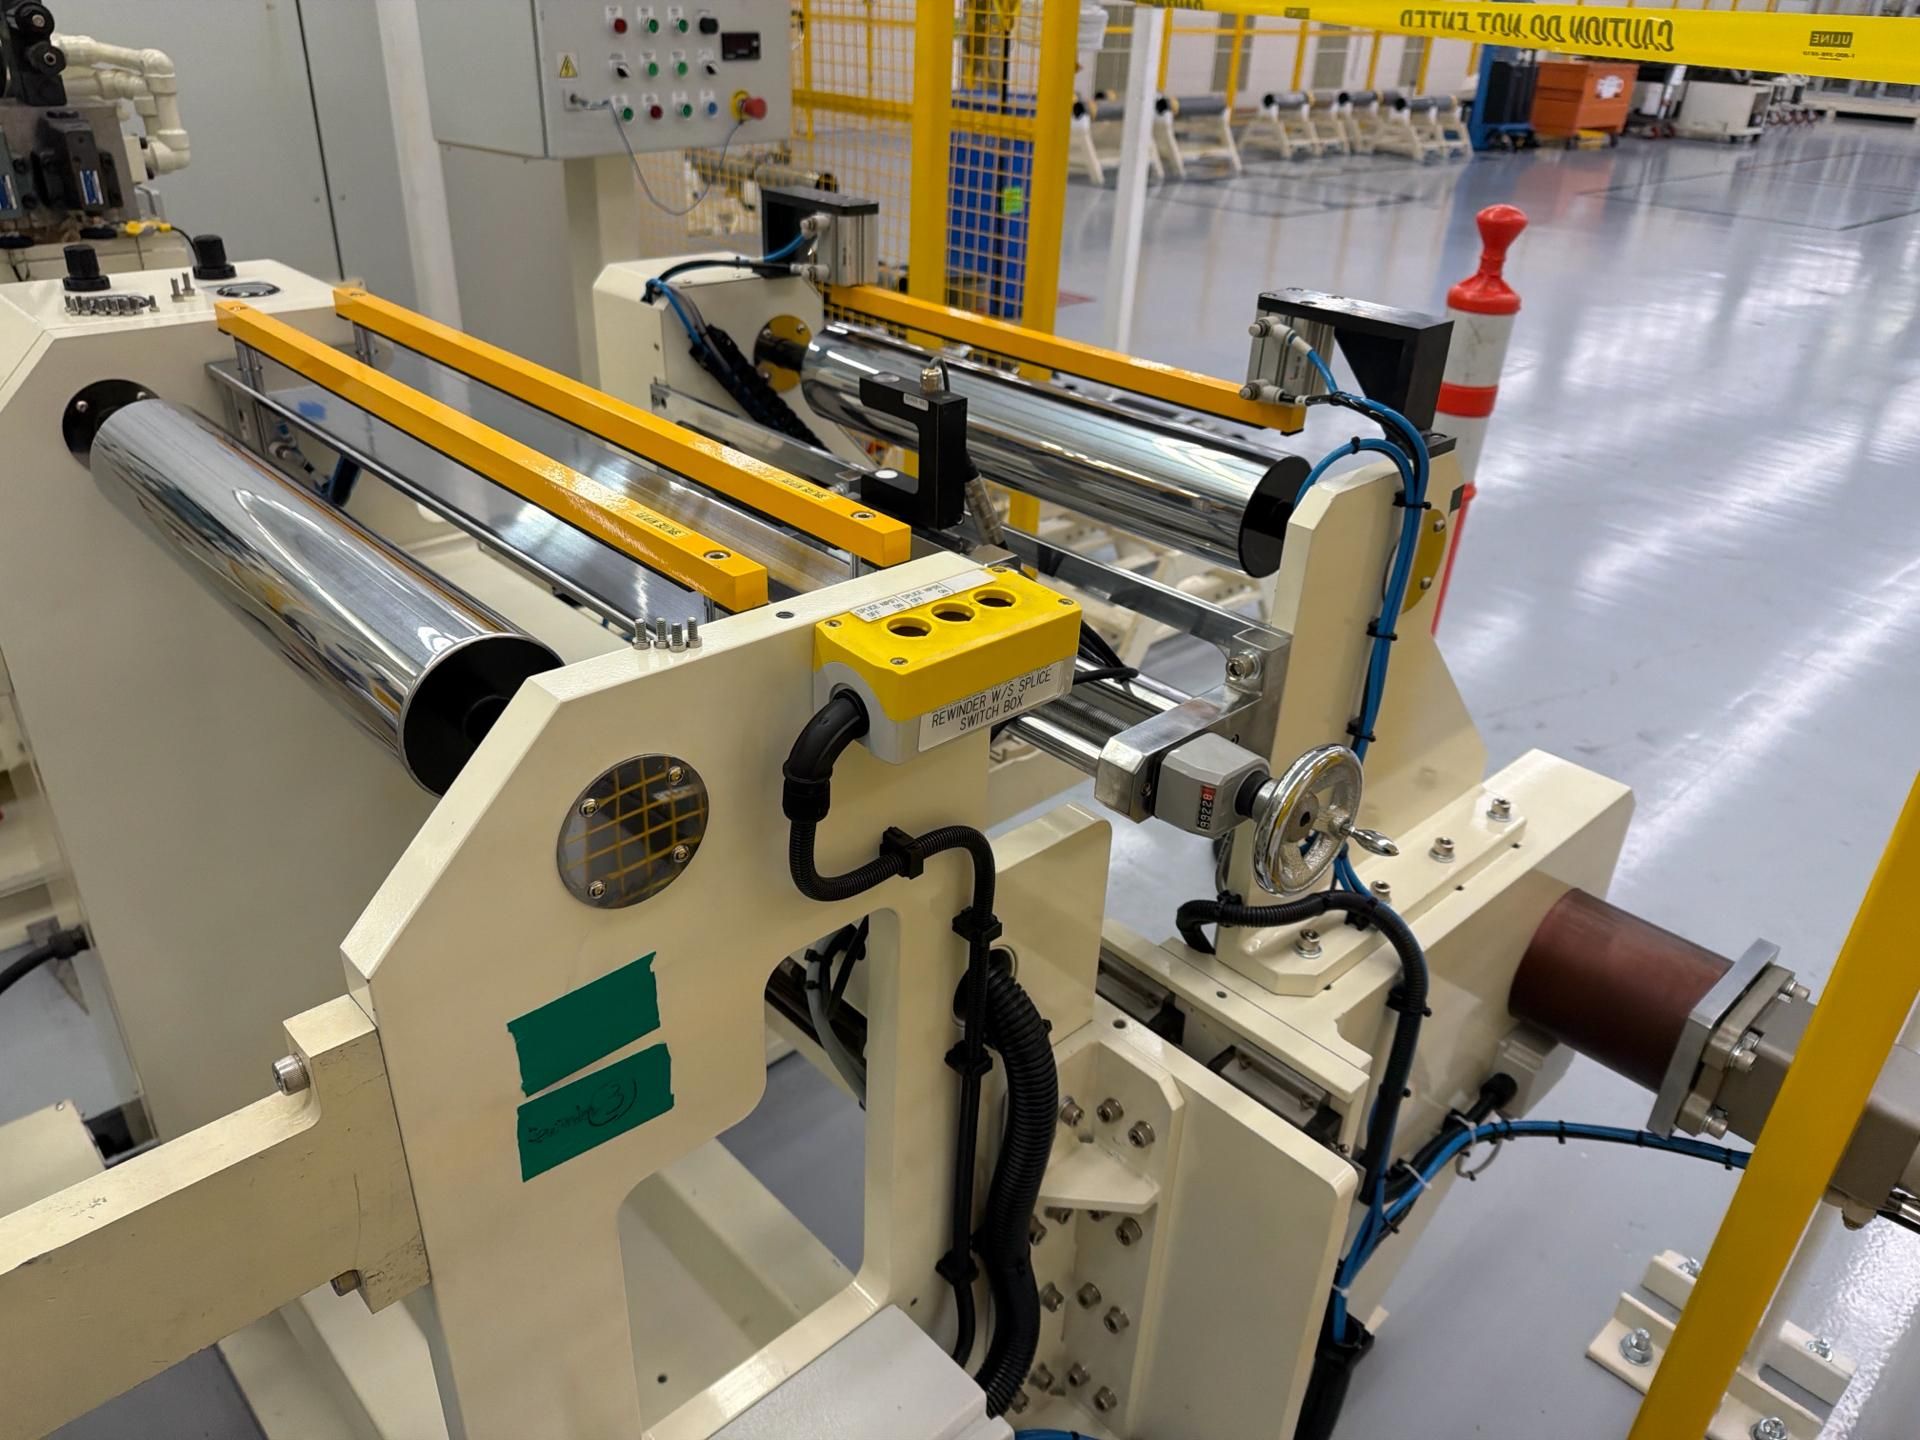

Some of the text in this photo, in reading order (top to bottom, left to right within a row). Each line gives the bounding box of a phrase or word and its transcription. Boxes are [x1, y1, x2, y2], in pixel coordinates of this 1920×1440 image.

[931, 668, 1052, 728] REWINDER W/S SPLICE
[959, 694, 1024, 731] SWITCH BOX
[1200, 793, 1213, 829] 99228
